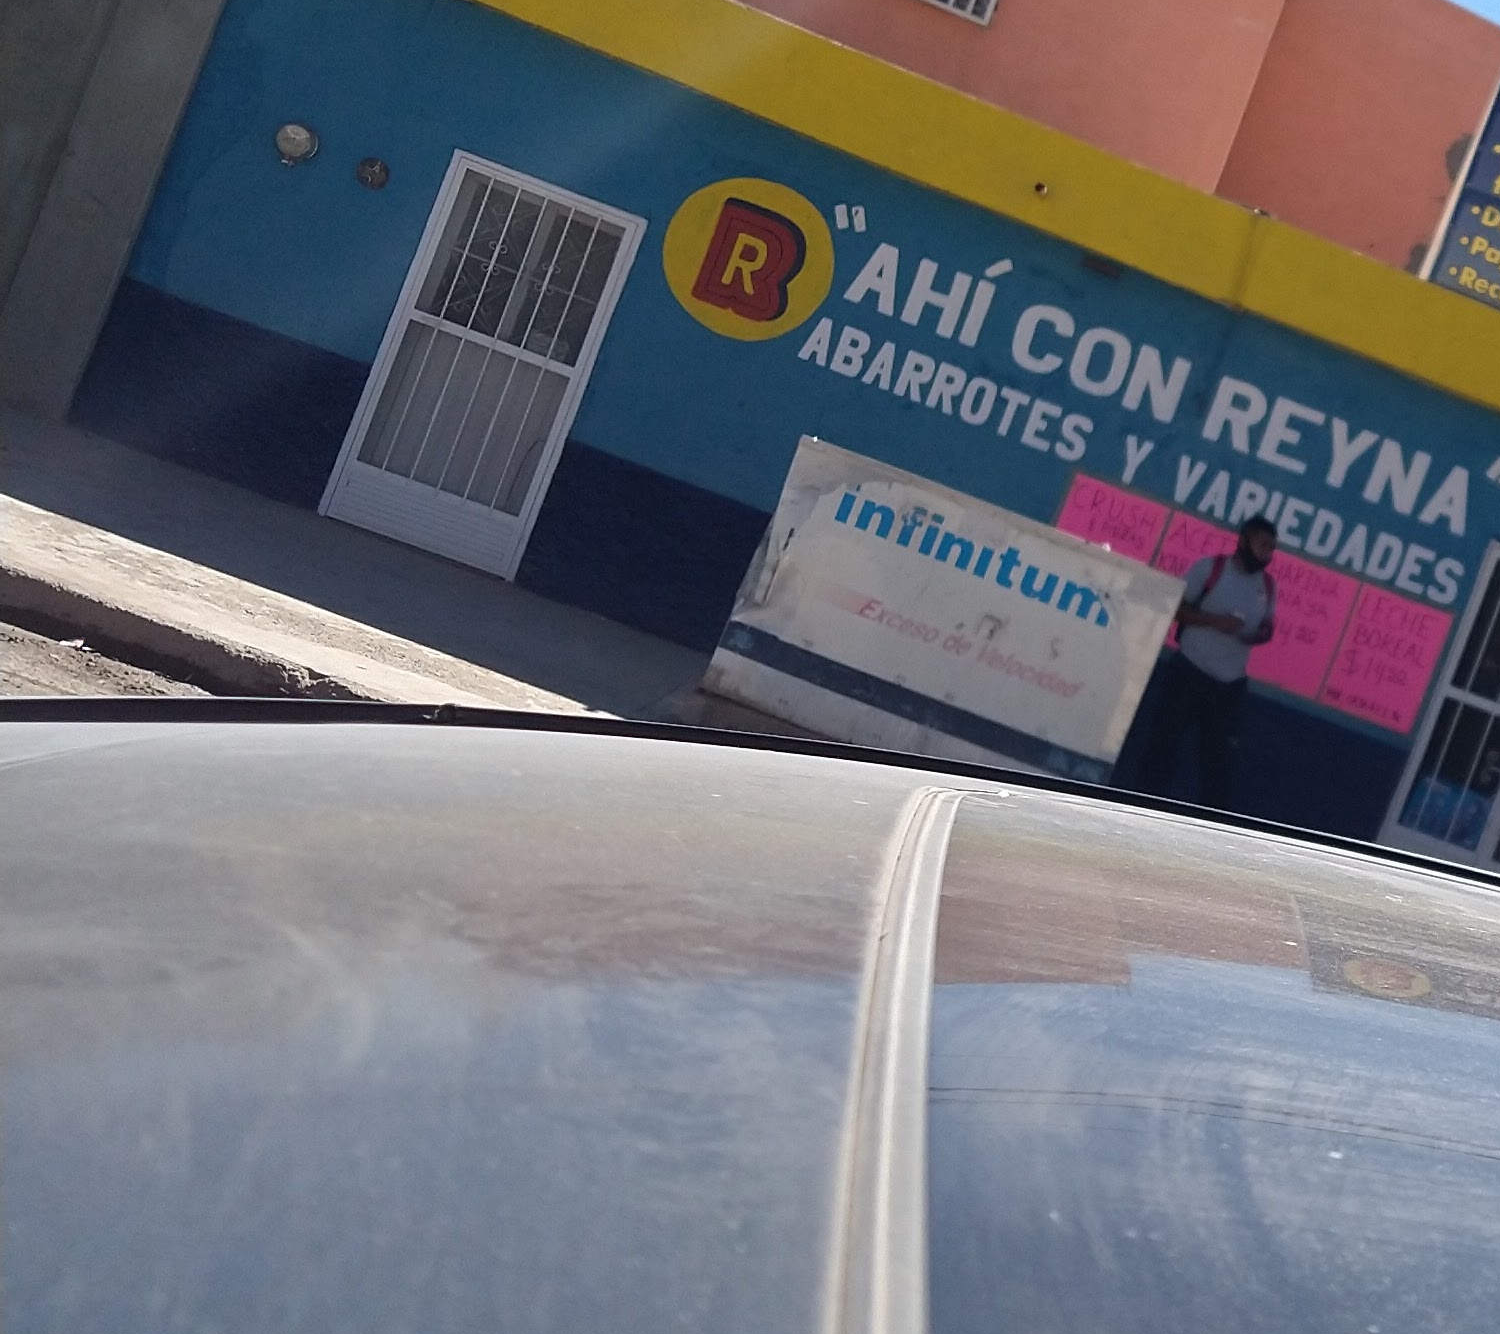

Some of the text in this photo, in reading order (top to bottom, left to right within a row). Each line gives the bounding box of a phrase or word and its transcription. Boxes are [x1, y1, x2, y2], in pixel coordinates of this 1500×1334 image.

[1011, 303, 1193, 424] CON
[797, 316, 1466, 606] ABARROTES Y VARIEDADES
[834, 484, 1110, 628] infinitum
[942, 633, 972, 657] de
